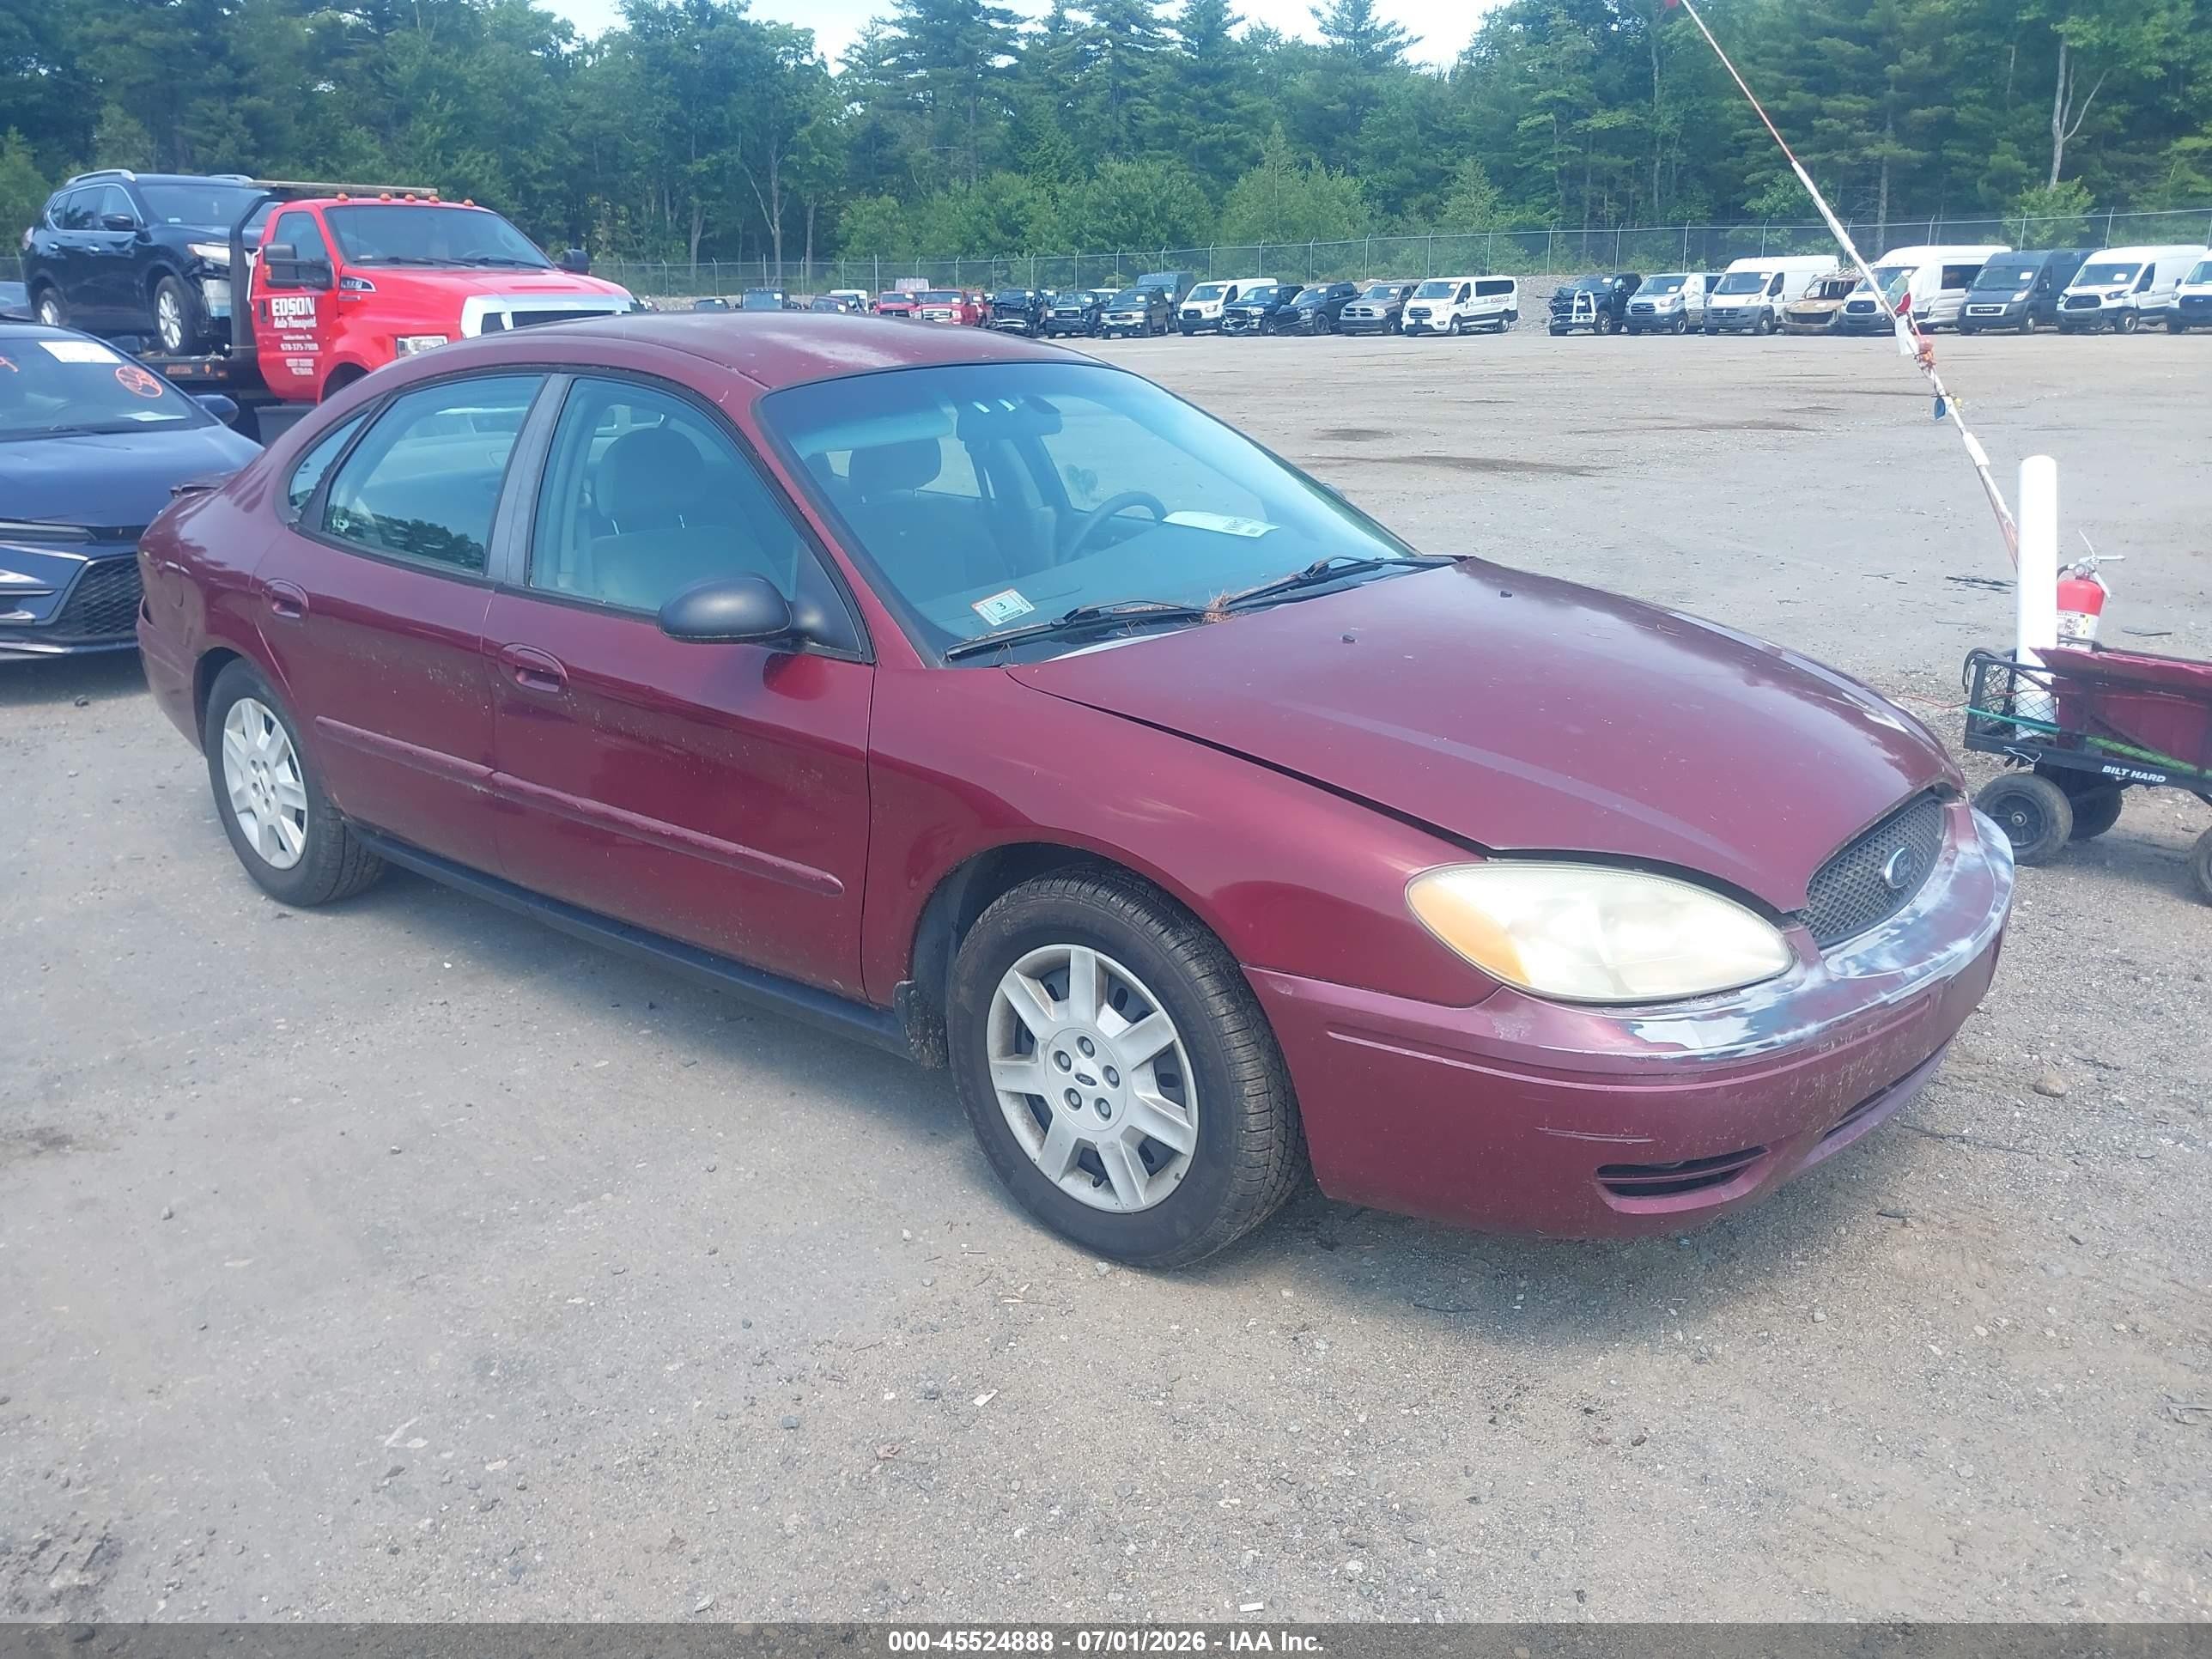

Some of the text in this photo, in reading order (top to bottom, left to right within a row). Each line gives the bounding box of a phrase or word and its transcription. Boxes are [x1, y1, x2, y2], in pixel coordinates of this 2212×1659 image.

[271, 296, 315, 317] EDSON
[273, 316, 288, 329] Auto
[995, 602, 1007, 611] 3
[2101, 765, 2166, 782] BILT HARD
